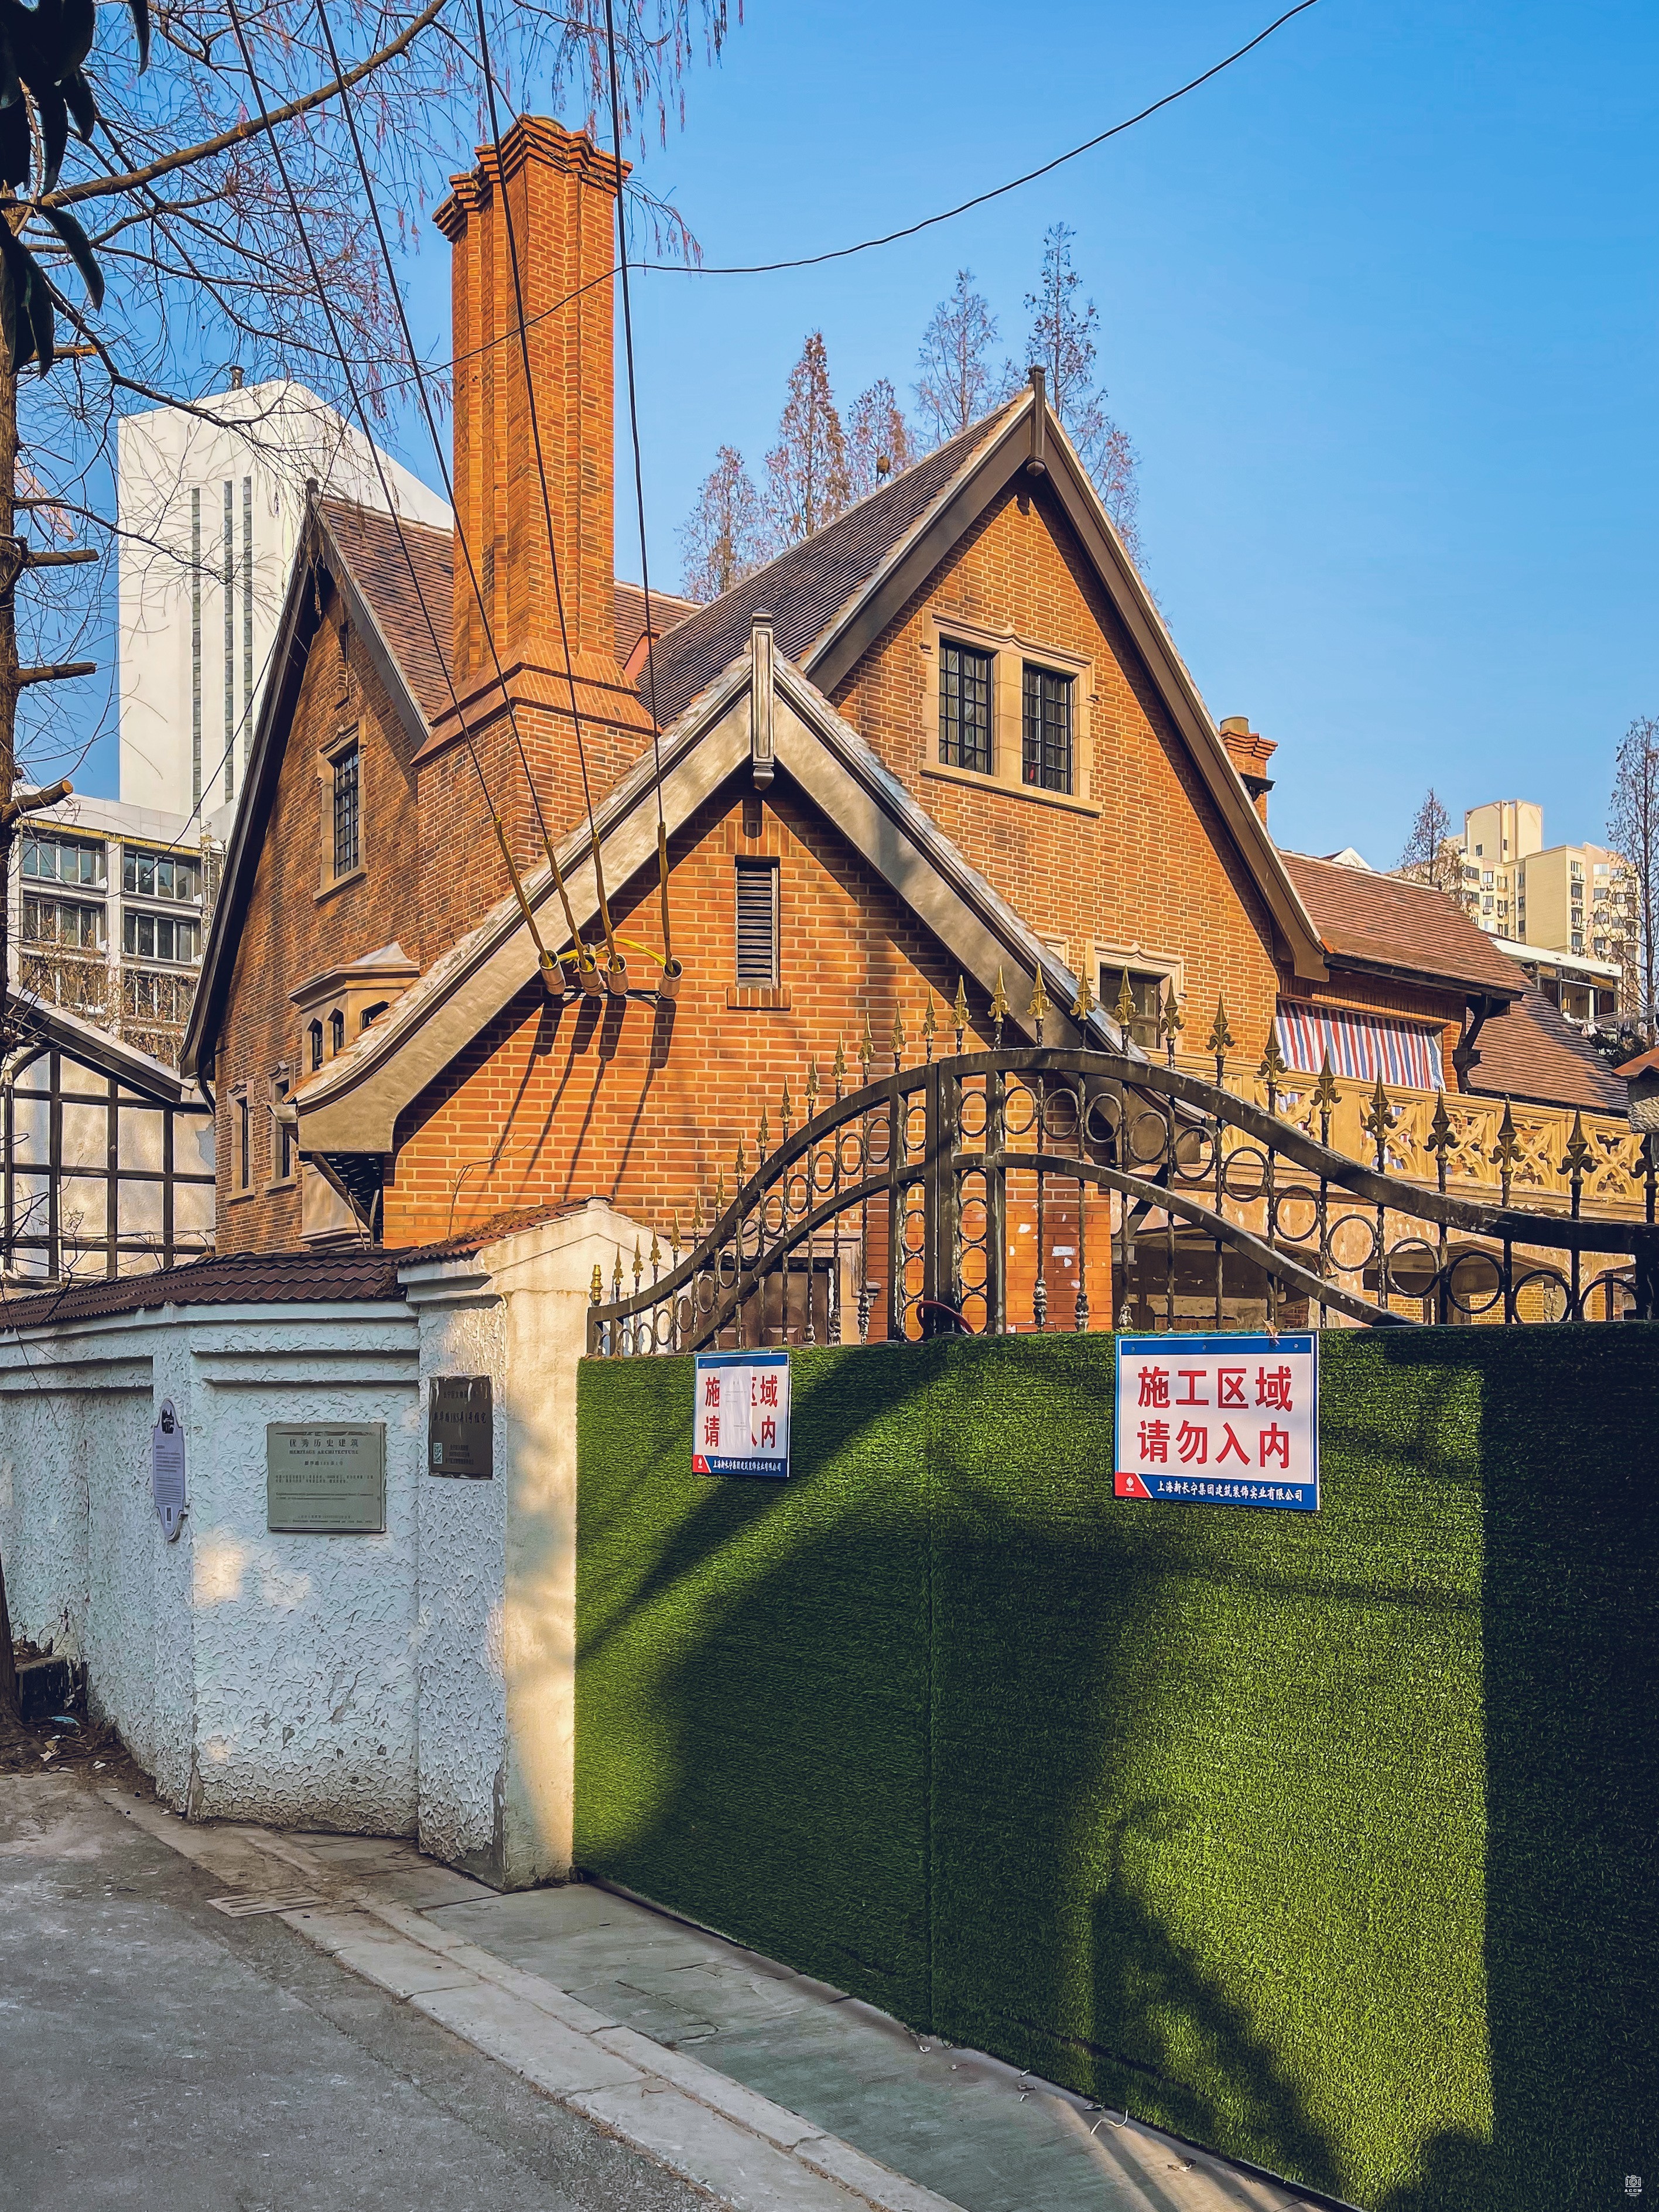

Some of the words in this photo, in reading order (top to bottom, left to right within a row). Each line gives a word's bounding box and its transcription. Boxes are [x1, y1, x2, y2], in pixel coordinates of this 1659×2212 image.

[705, 1375, 778, 1408] 施域
[1137, 1365, 1294, 1412] 施工区域
[289, 1438, 359, 1447] 优秀历史建筑
[704, 1416, 776, 1449] 请内
[1137, 1419, 1289, 1469] 请勿入内
[1157, 1481, 1302, 1502] 上海新长宁集团建筑装饰实业有限公司
